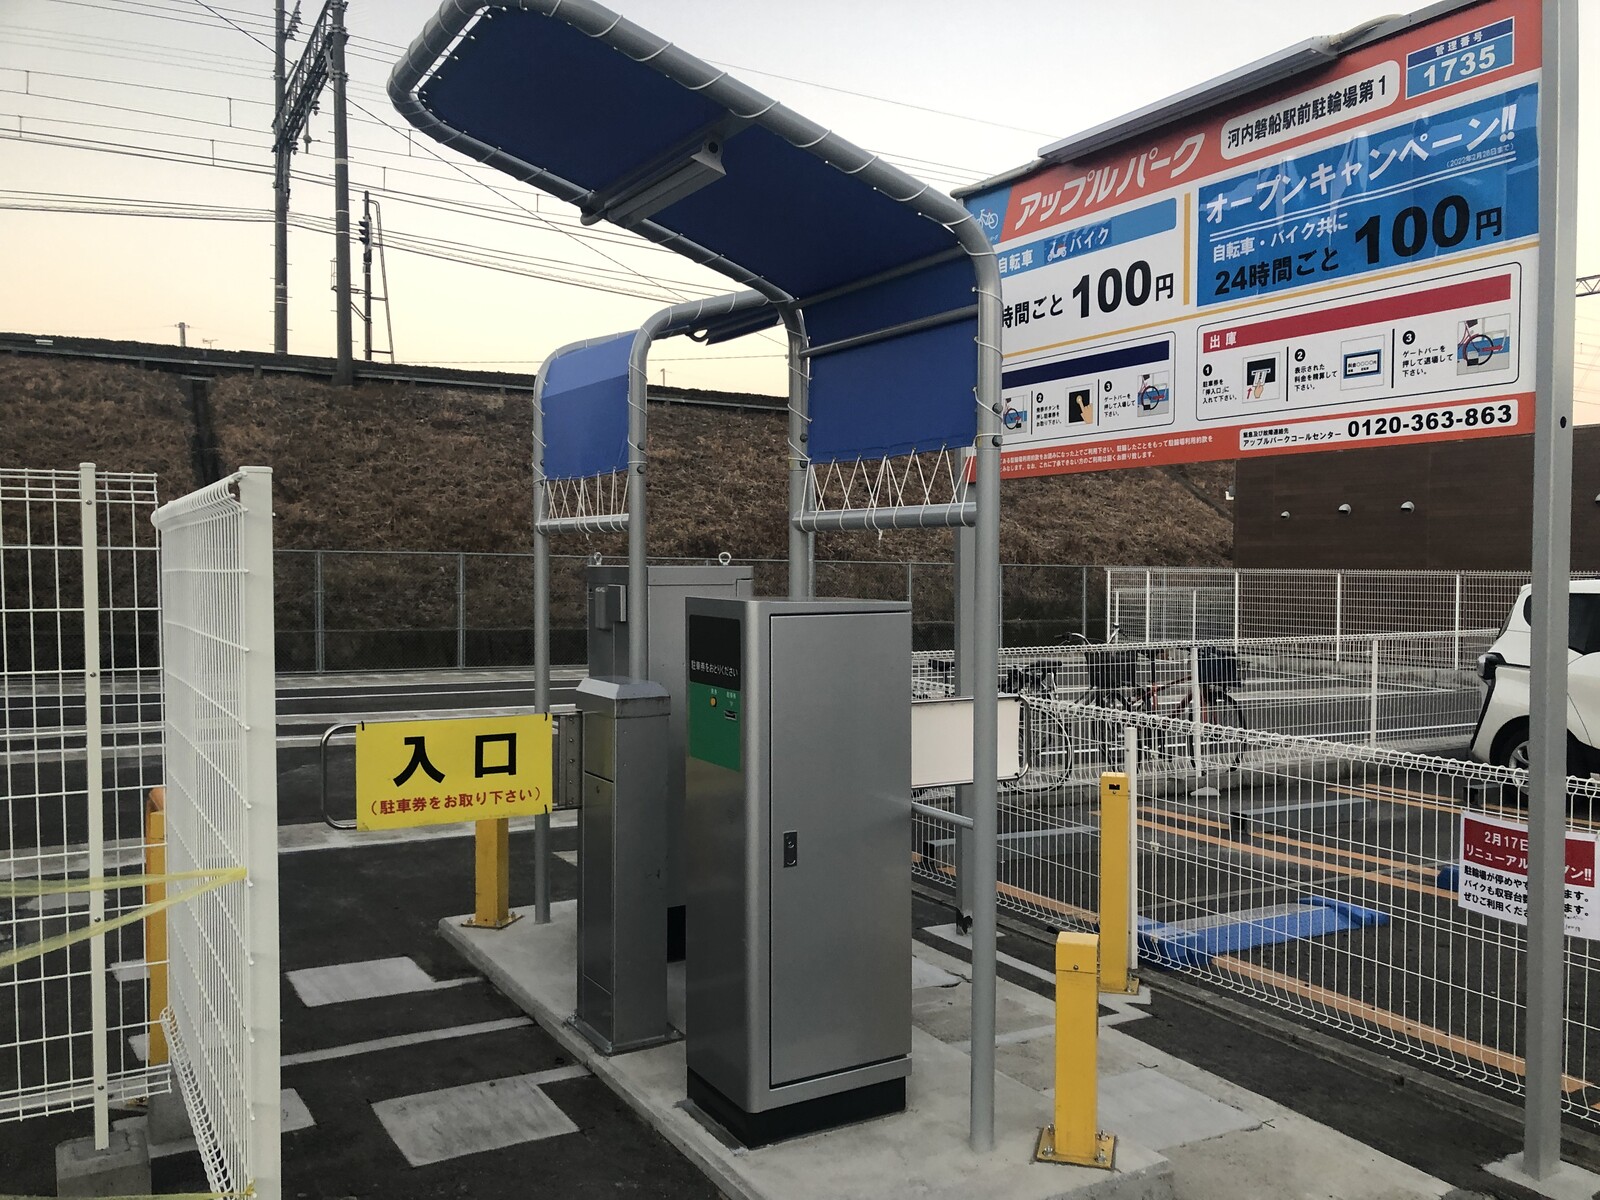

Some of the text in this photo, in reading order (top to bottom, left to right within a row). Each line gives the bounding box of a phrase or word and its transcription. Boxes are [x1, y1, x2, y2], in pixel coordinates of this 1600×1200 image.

[1424, 44, 1496, 87] 1735
[1435, 31, 1483, 57] 管理番号
[1227, 75, 1387, 149] 河内磐船駅前駐輪場第1
[1014, 132, 1206, 231] アップルパーク
[998, 227, 1109, 273] 自転車 バイク
[1213, 212, 1348, 263] 自転車・バイク共に
[1214, 248, 1339, 296] 24時間ごと
[1209, 331, 1237, 349] 出庫
[1347, 404, 1512, 438] 0120-363-863
[393, 733, 516, 787] 入口
